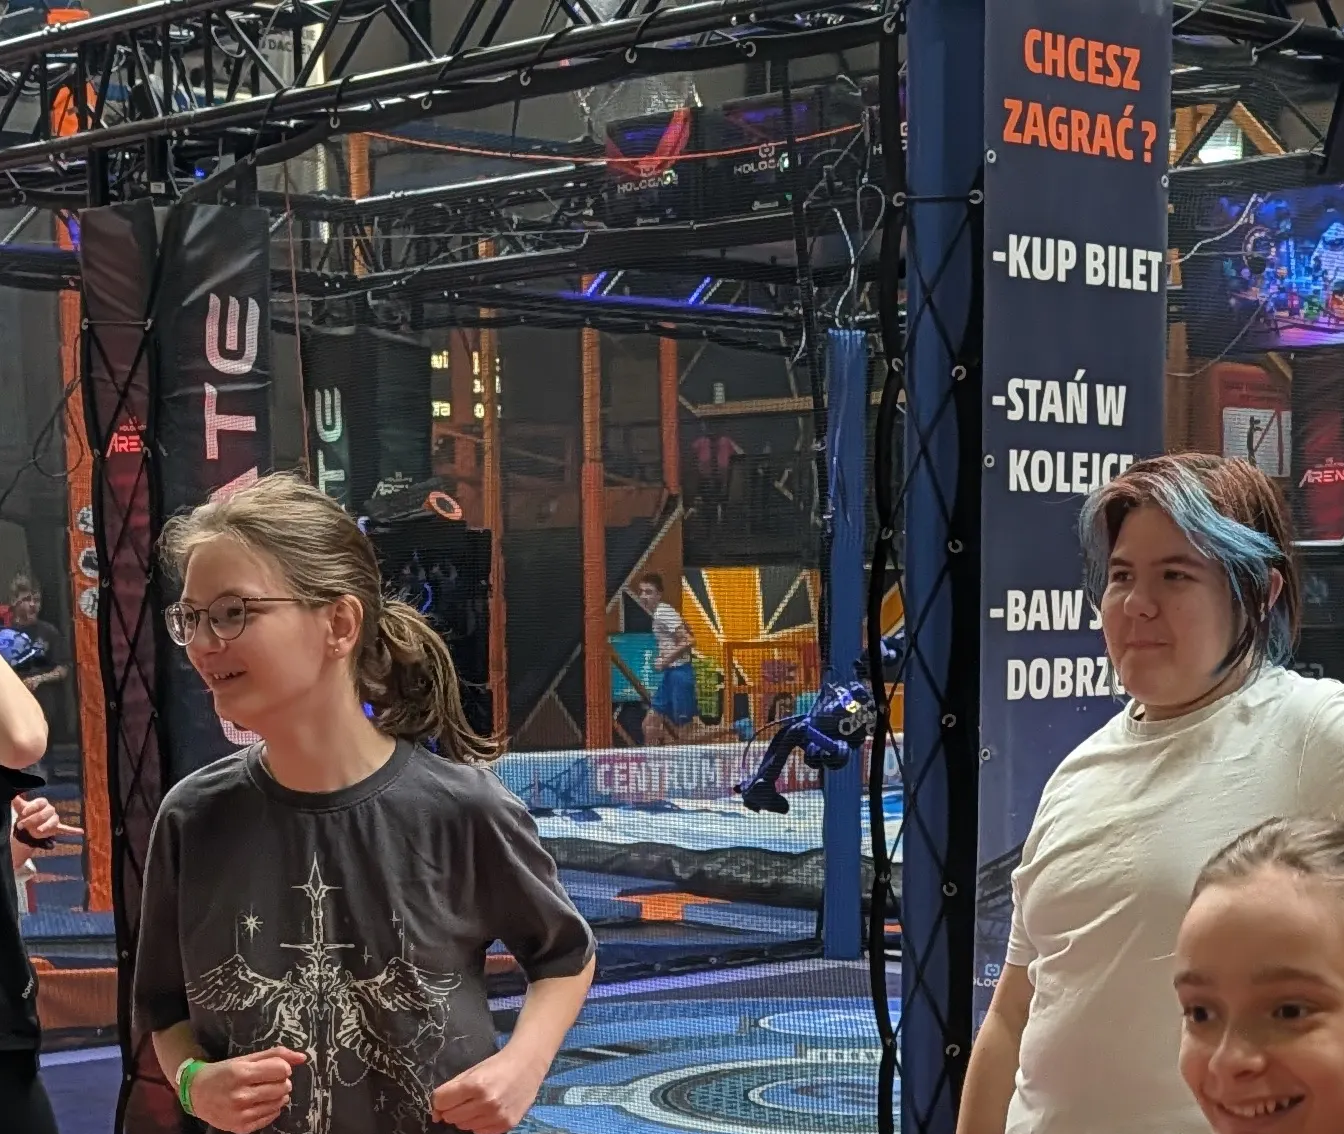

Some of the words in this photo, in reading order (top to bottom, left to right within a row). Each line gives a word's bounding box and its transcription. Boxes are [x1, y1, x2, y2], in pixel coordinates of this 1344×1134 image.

[1024, 28, 1141, 91] CHCESZ
[1003, 98, 1134, 161] ZAGRAĆ
[1141, 120, 1158, 164] ?
[992, 233, 1077, 284] -KUP
[1085, 242, 1163, 293] BILET
[1095, 383, 1127, 427] W
[106, 432, 148, 458] ARE
